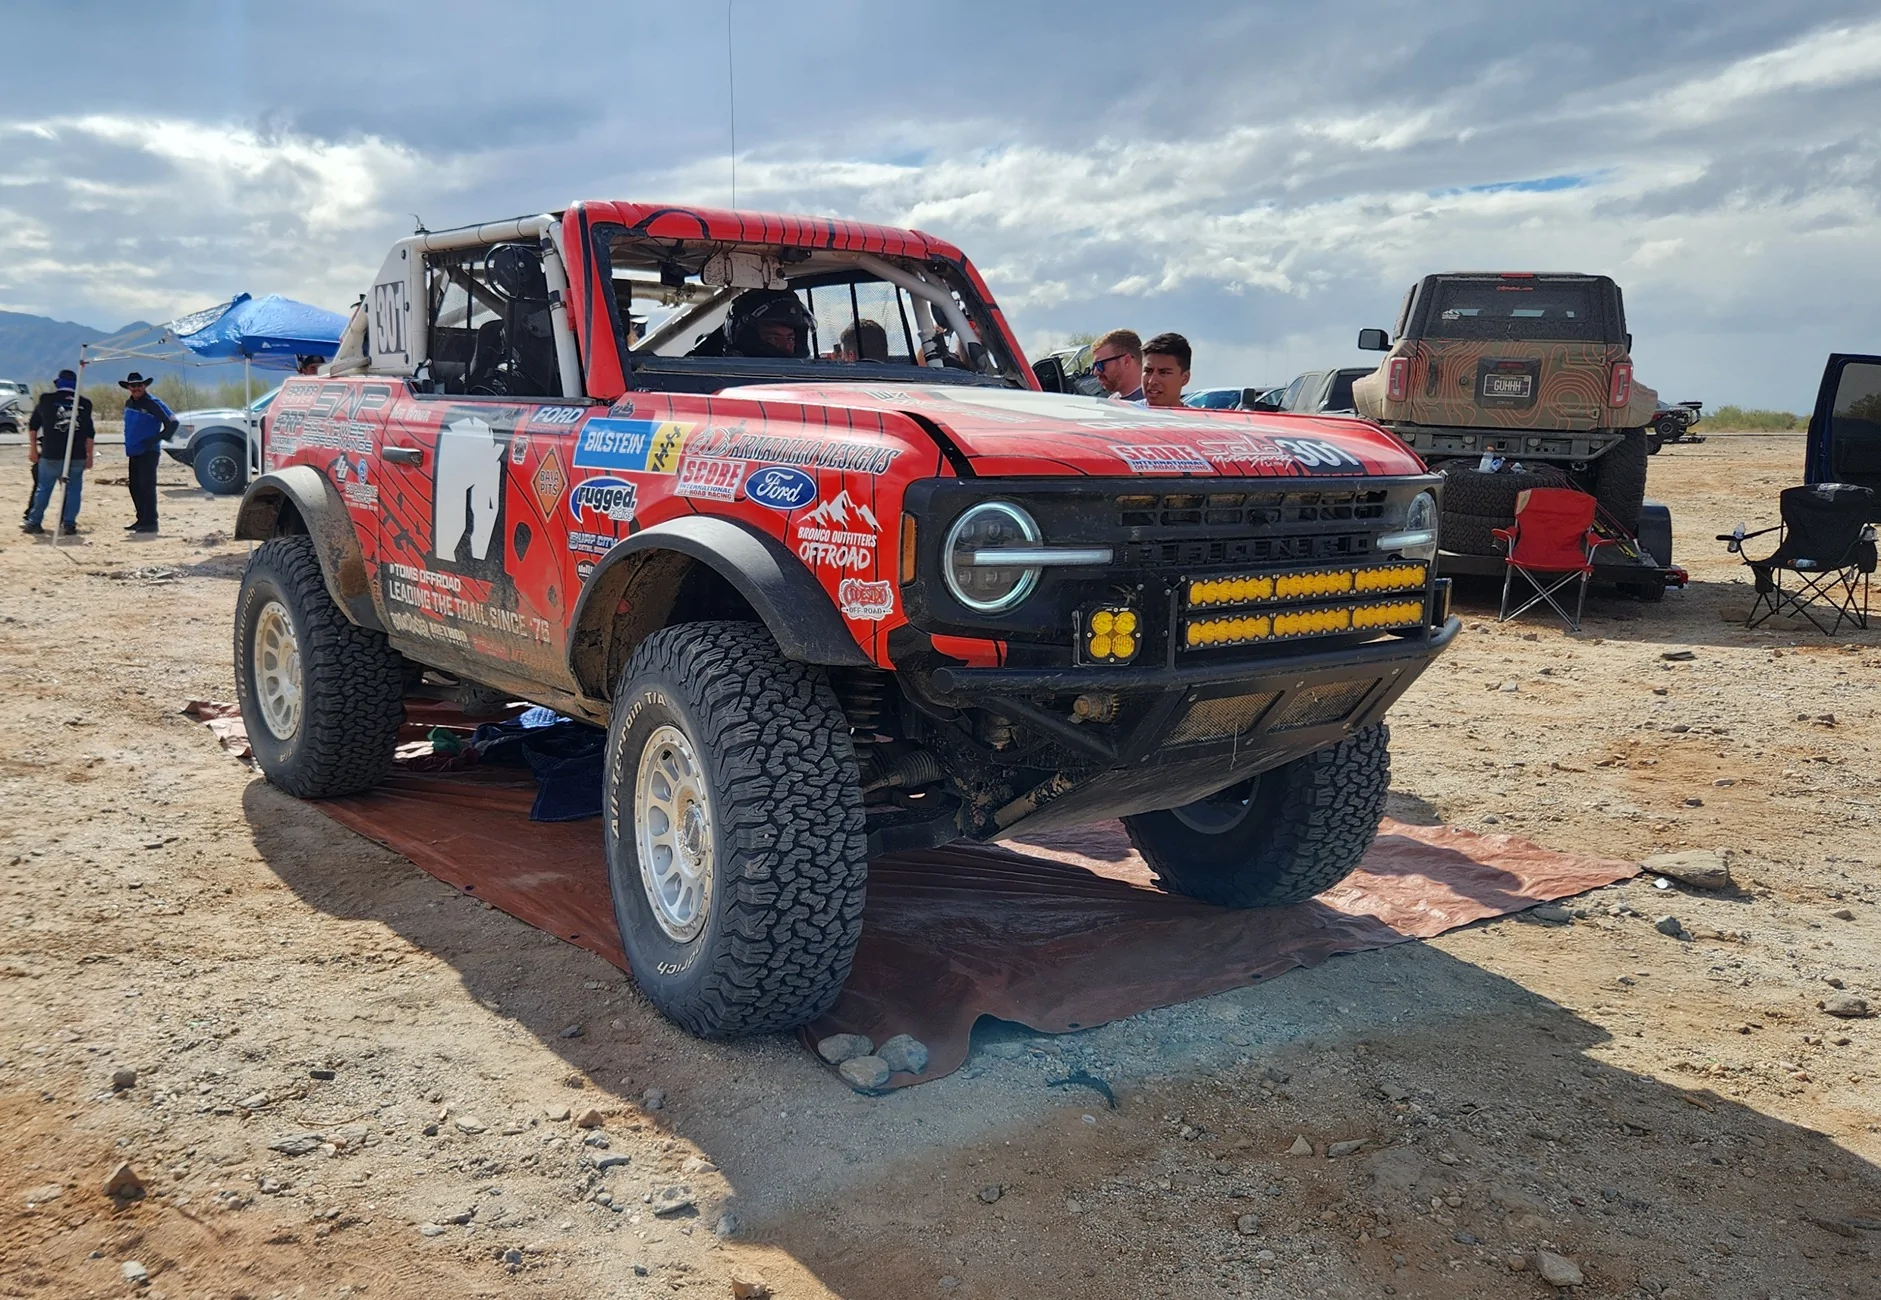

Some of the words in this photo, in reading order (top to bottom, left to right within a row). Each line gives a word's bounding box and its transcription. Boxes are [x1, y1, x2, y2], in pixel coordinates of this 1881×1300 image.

[376, 282, 406, 353] 301
[531, 407, 584, 424] FORD
[584, 431, 645, 454] BILSTEIN
[1115, 446, 1203, 461] SCORE
[1274, 439, 1360, 468] 301
[816, 441, 904, 475] DESIGNS
[682, 460, 742, 488] SCORE
[540, 484, 558, 496] PITS
[679, 483, 733, 494] INTERNATIONAL
[707, 490, 732, 500] RACING
[756, 471, 804, 503] Ford
[609, 508, 635, 520] radios
[797, 526, 831, 543] BRONCO
[831, 530, 878, 548] OUTFITTERS
[799, 541, 871, 571] OFFROAD
[419, 569, 461, 592] OFFROAD
[389, 580, 431, 611] LEADING
[431, 589, 455, 616] THE
[454, 597, 489, 626] TRAIL
[489, 606, 528, 638] SINCE
[848, 606, 883, 615] OFF-ROAD
[429, 621, 468, 643] METHOD
[609, 700, 643, 840] All-Terrain
